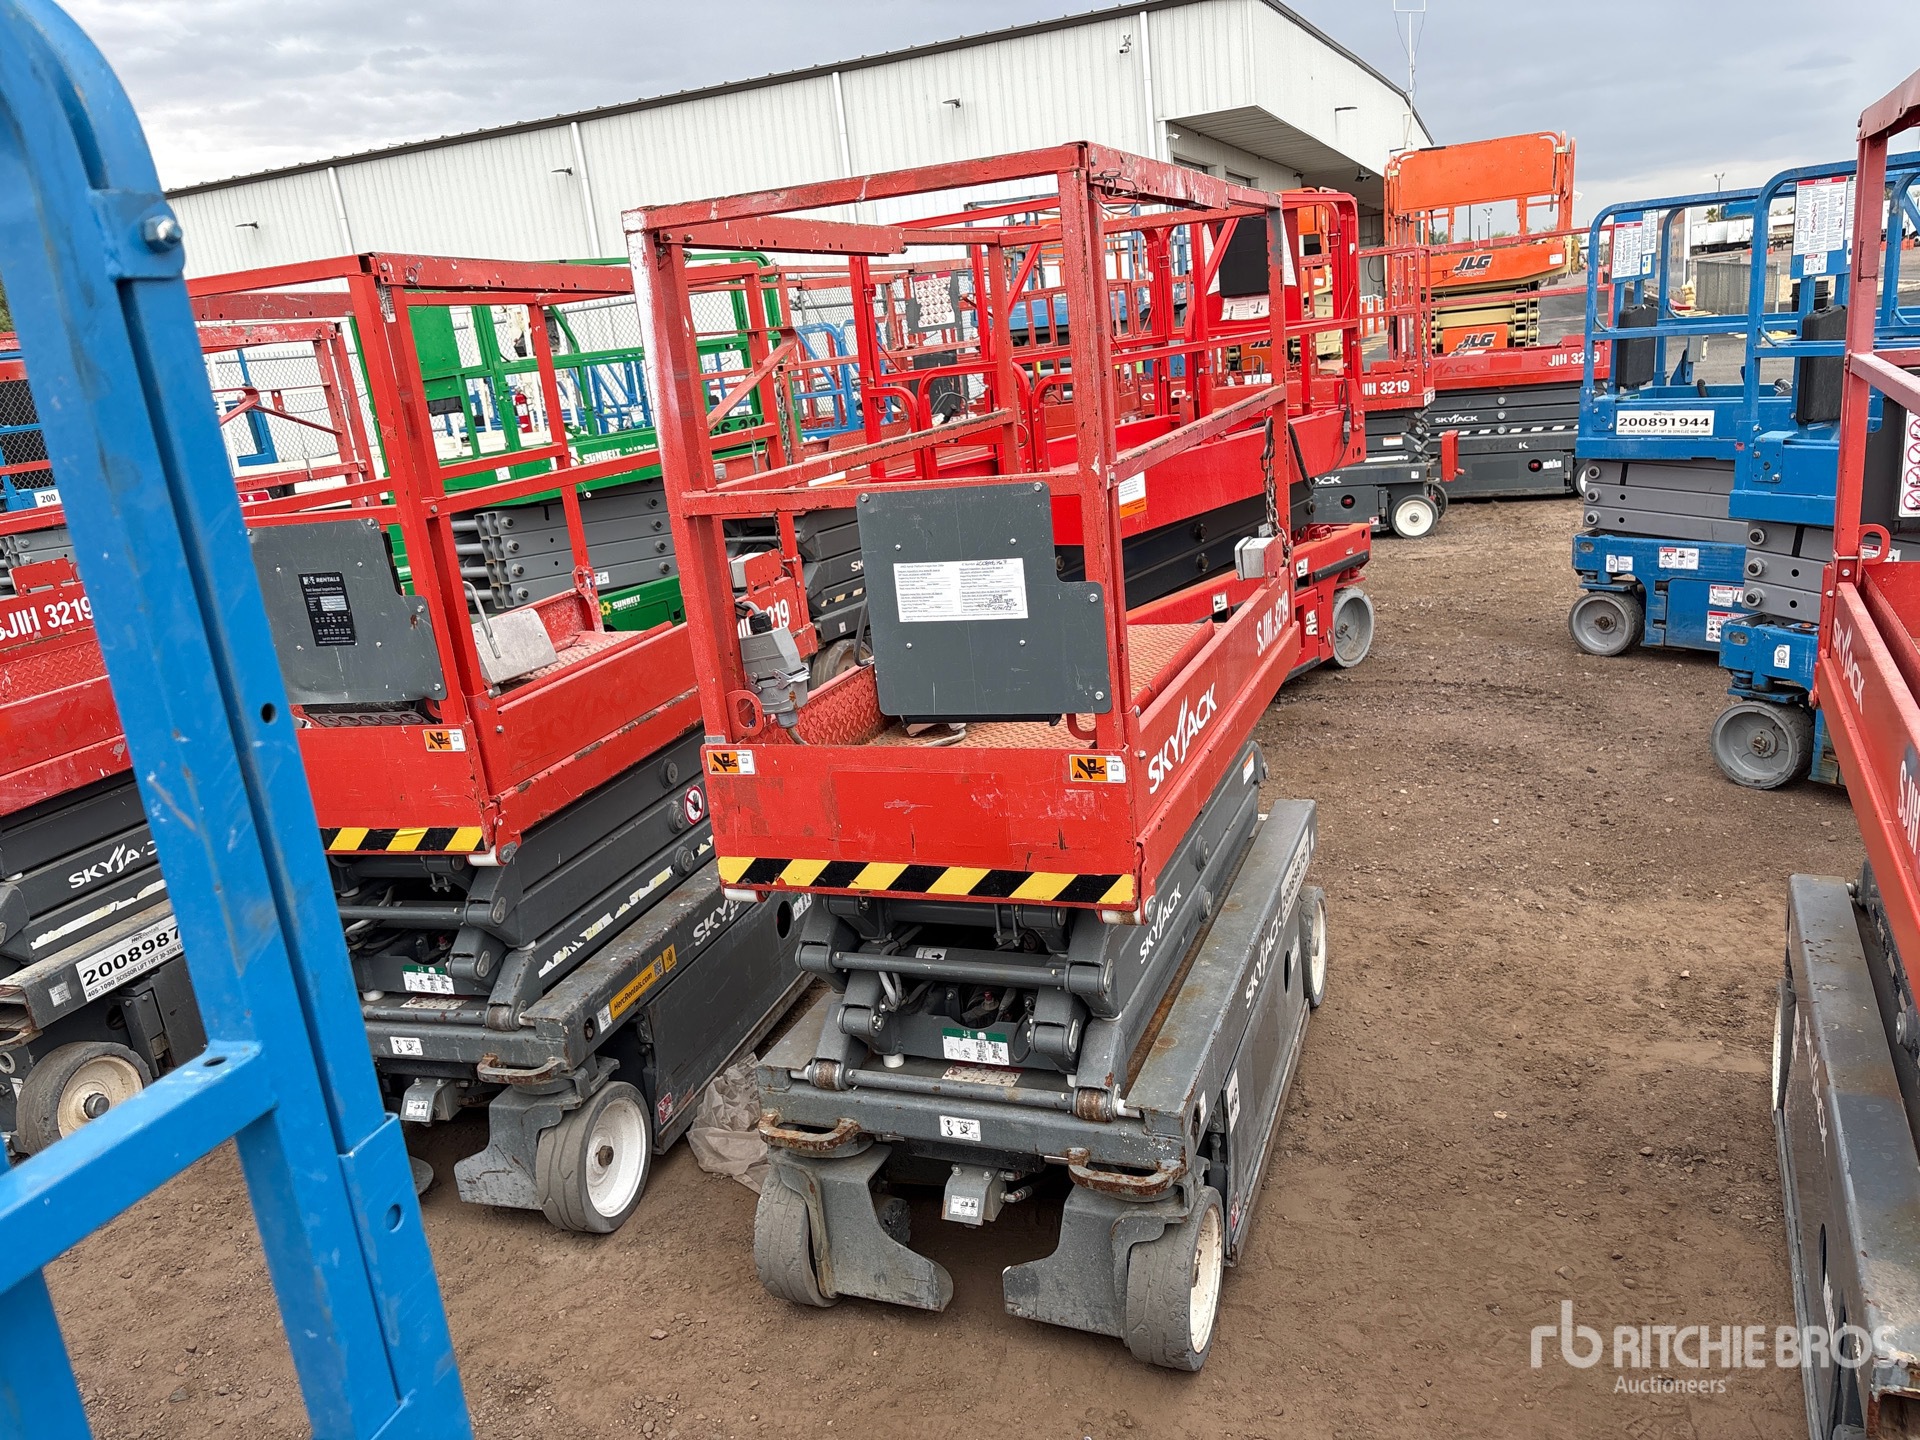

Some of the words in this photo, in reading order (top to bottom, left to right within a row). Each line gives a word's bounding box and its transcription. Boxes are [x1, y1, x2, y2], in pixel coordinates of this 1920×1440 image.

[1453, 254, 1493, 271] JLG
[1457, 332, 1497, 348] JLG
[1571, 350, 1600, 366] 329
[1379, 379, 1410, 395] 3219
[1435, 413, 1478, 424] SKYJACK
[1618, 417, 1710, 427] 200891944
[582, 448, 622, 464] SUNBELT
[41, 493, 57, 504] 200
[612, 594, 640, 609] SUNBELT
[44, 596, 94, 629] 3219
[760, 598, 790, 631] 219
[1273, 589, 1289, 636] 3219
[1832, 617, 1865, 715] SKYJACK
[1148, 682, 1218, 794] SKYJACK
[1140, 881, 1182, 964] SKYJACK
[87, 979, 115, 998] 405-1090
[116, 964, 138, 982] SCISSOR
[137, 961, 148, 972] LIFT
[613, 971, 654, 1012] HercRentals.com
